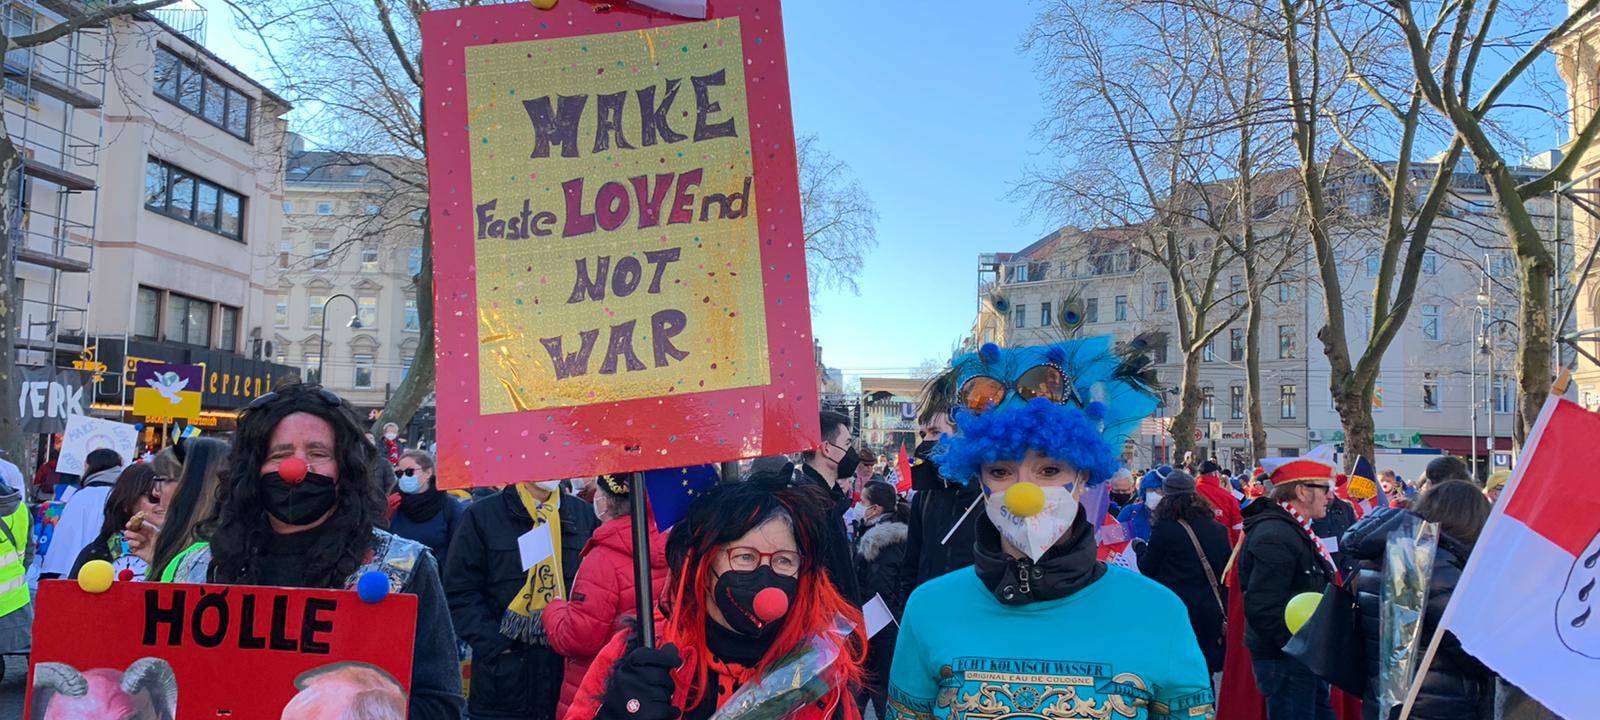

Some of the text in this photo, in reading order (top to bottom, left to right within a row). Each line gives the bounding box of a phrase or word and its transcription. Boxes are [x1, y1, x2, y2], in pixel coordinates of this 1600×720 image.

[522, 68, 738, 158] MAKE
[566, 247, 681, 304] NOT
[539, 308, 690, 380] WAR
[1496, 455, 1507, 465] U
[142, 586, 337, 655] HÖLLE
[958, 658, 986, 671] ECHT
[1054, 663, 1103, 676] WASSER
[966, 672, 1007, 681] ORIGINAL
[1046, 676, 1091, 684] COLOGNE
